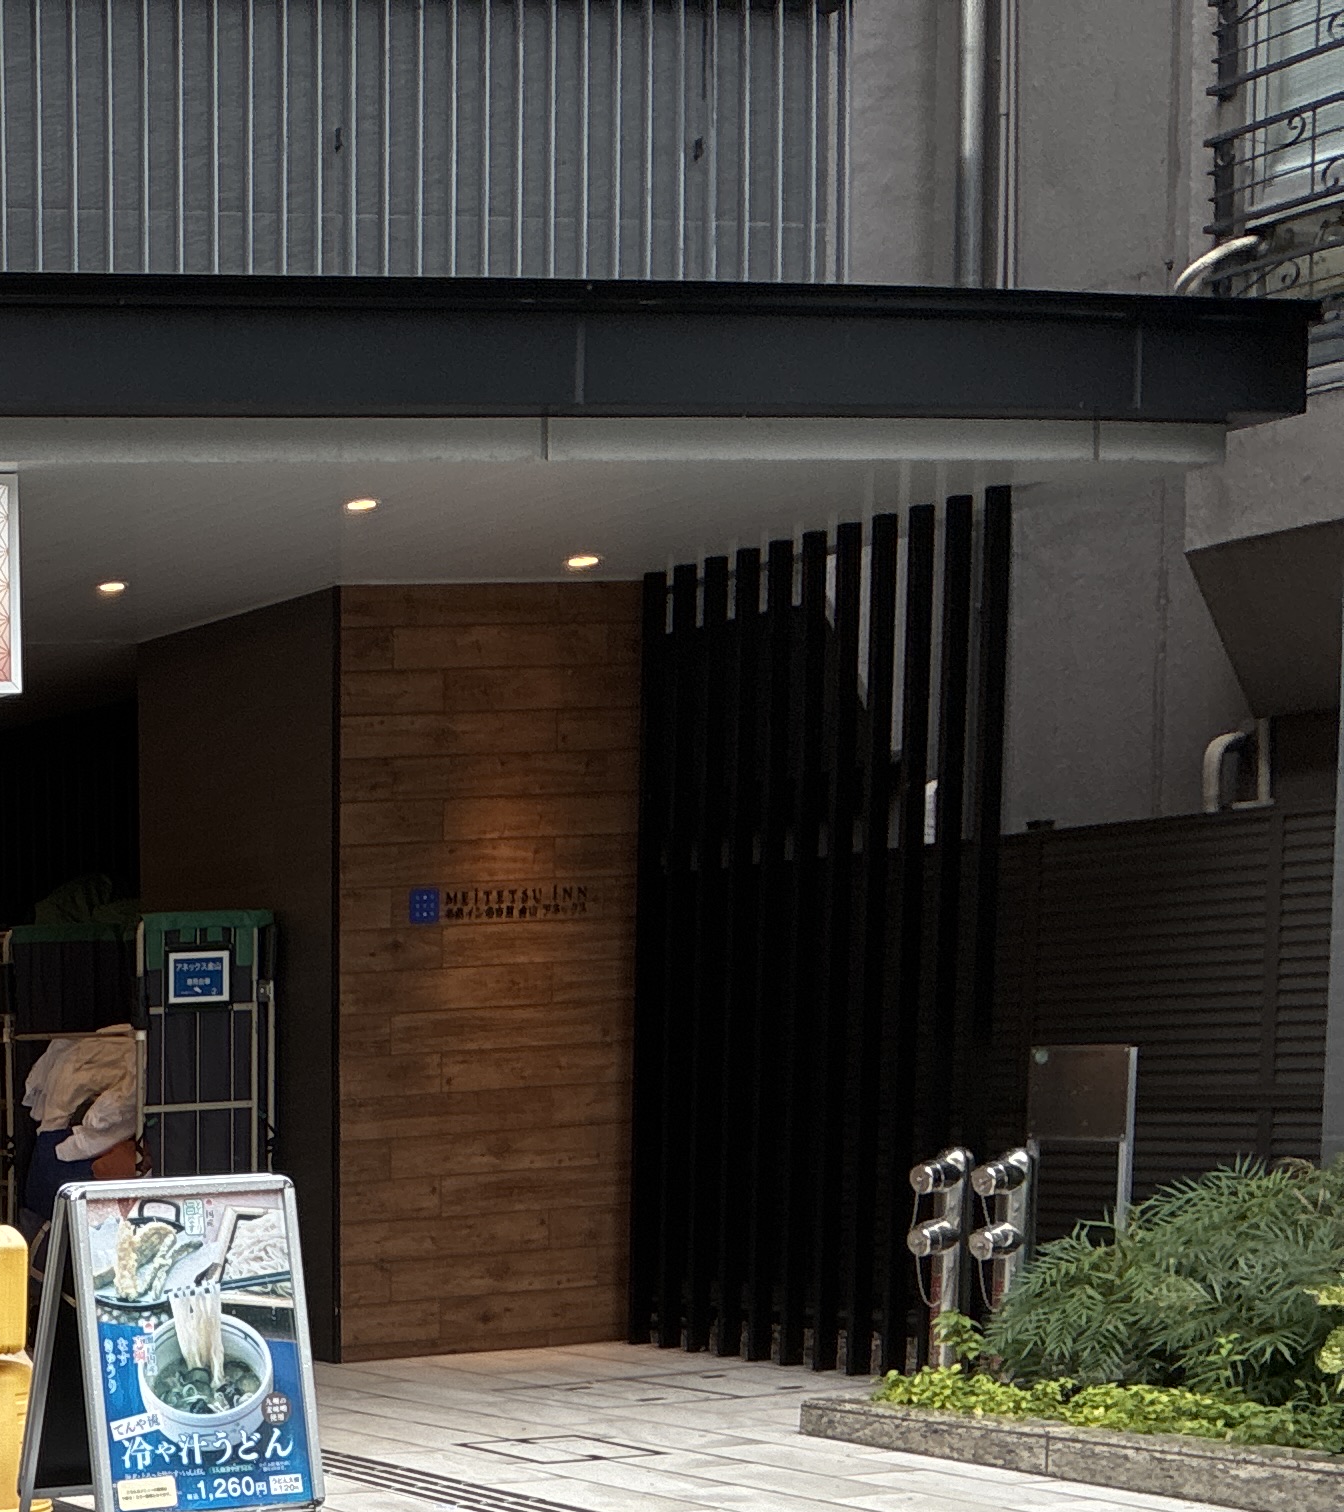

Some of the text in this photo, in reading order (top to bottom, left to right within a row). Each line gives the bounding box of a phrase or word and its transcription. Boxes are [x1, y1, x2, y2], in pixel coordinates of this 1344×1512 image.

[121, 1428, 294, 1470] 冷や汁うどん
